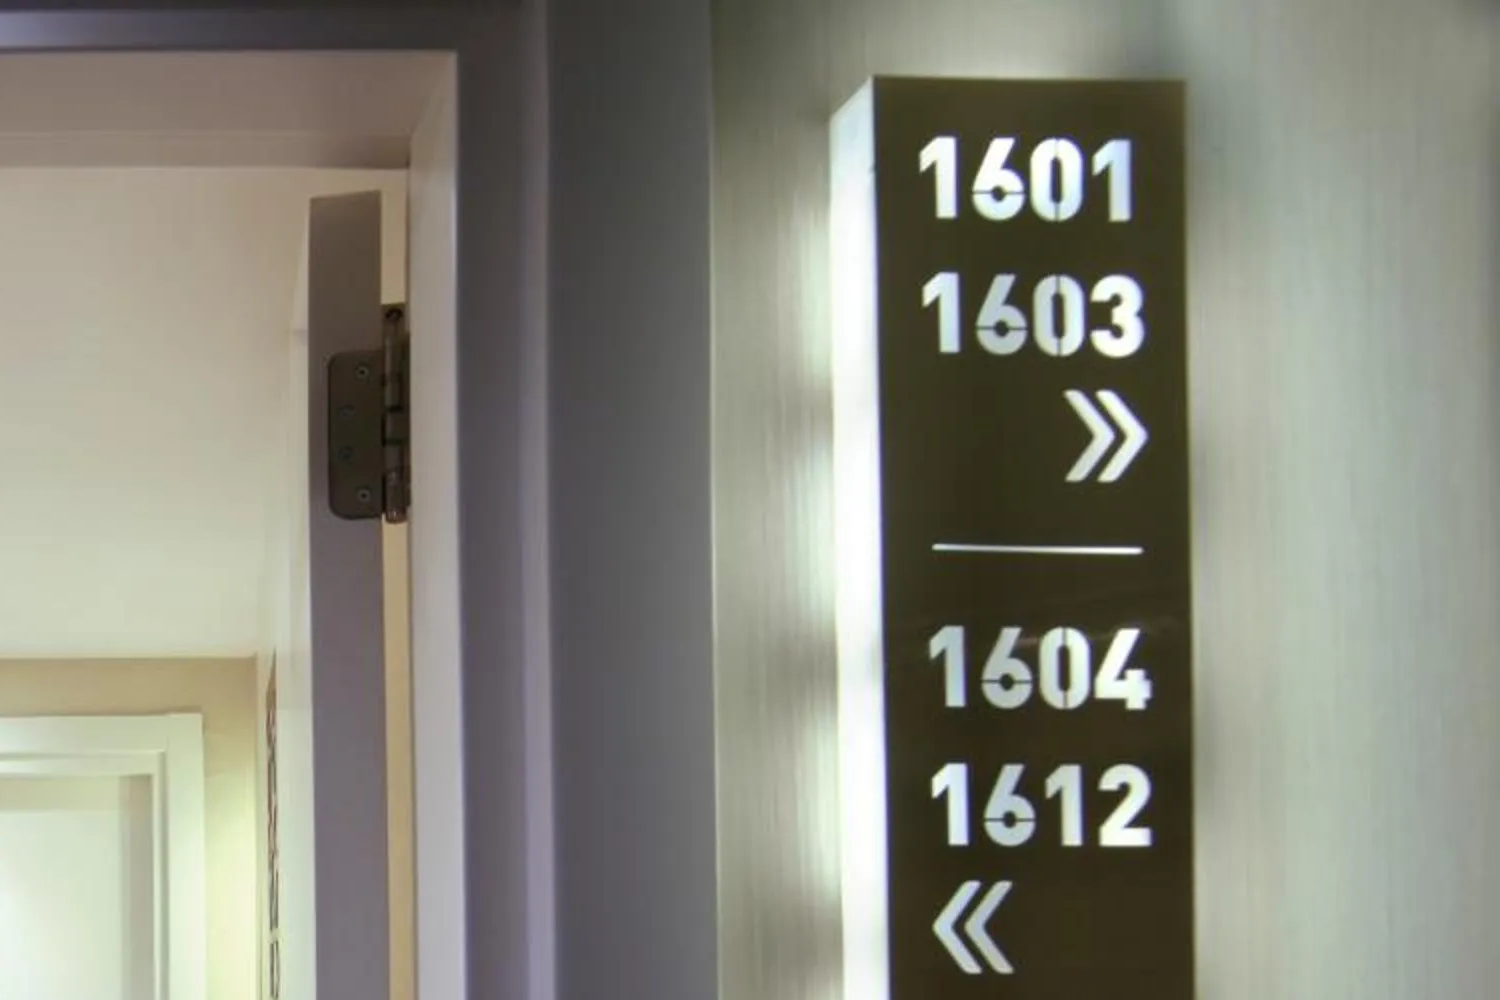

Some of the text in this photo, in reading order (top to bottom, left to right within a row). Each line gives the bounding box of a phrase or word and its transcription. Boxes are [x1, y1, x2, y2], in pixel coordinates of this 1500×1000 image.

[918, 135, 1132, 222] 1601
[921, 271, 1145, 358] 1603
[928, 625, 1152, 710] 1604
[930, 763, 1152, 847] 1612
